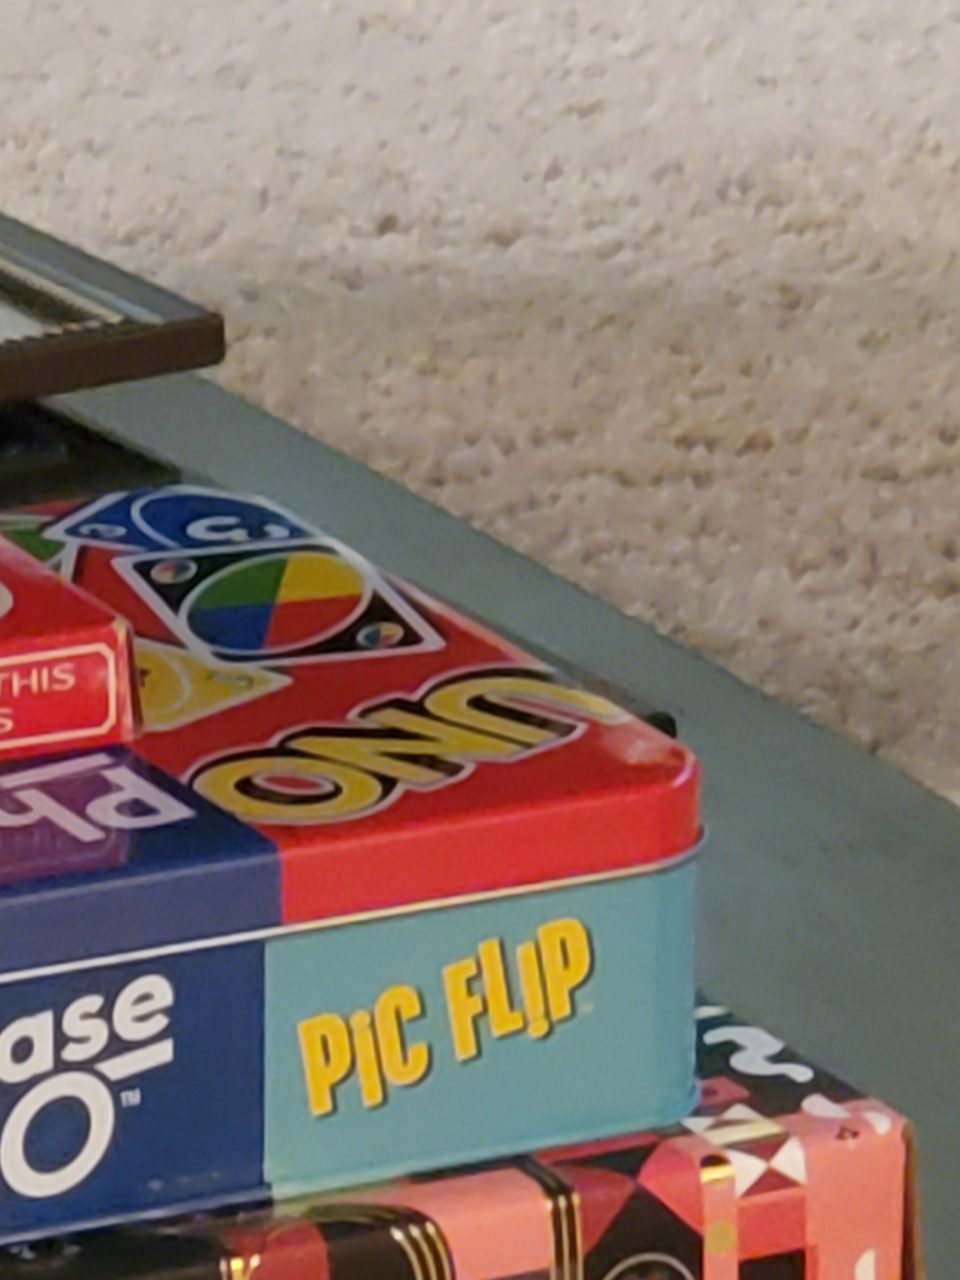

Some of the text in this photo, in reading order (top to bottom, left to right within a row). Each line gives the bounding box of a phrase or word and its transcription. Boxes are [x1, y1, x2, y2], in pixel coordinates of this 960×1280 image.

[186, 665, 632, 826] UNO
[296, 916, 596, 1119] PIC FLIP
